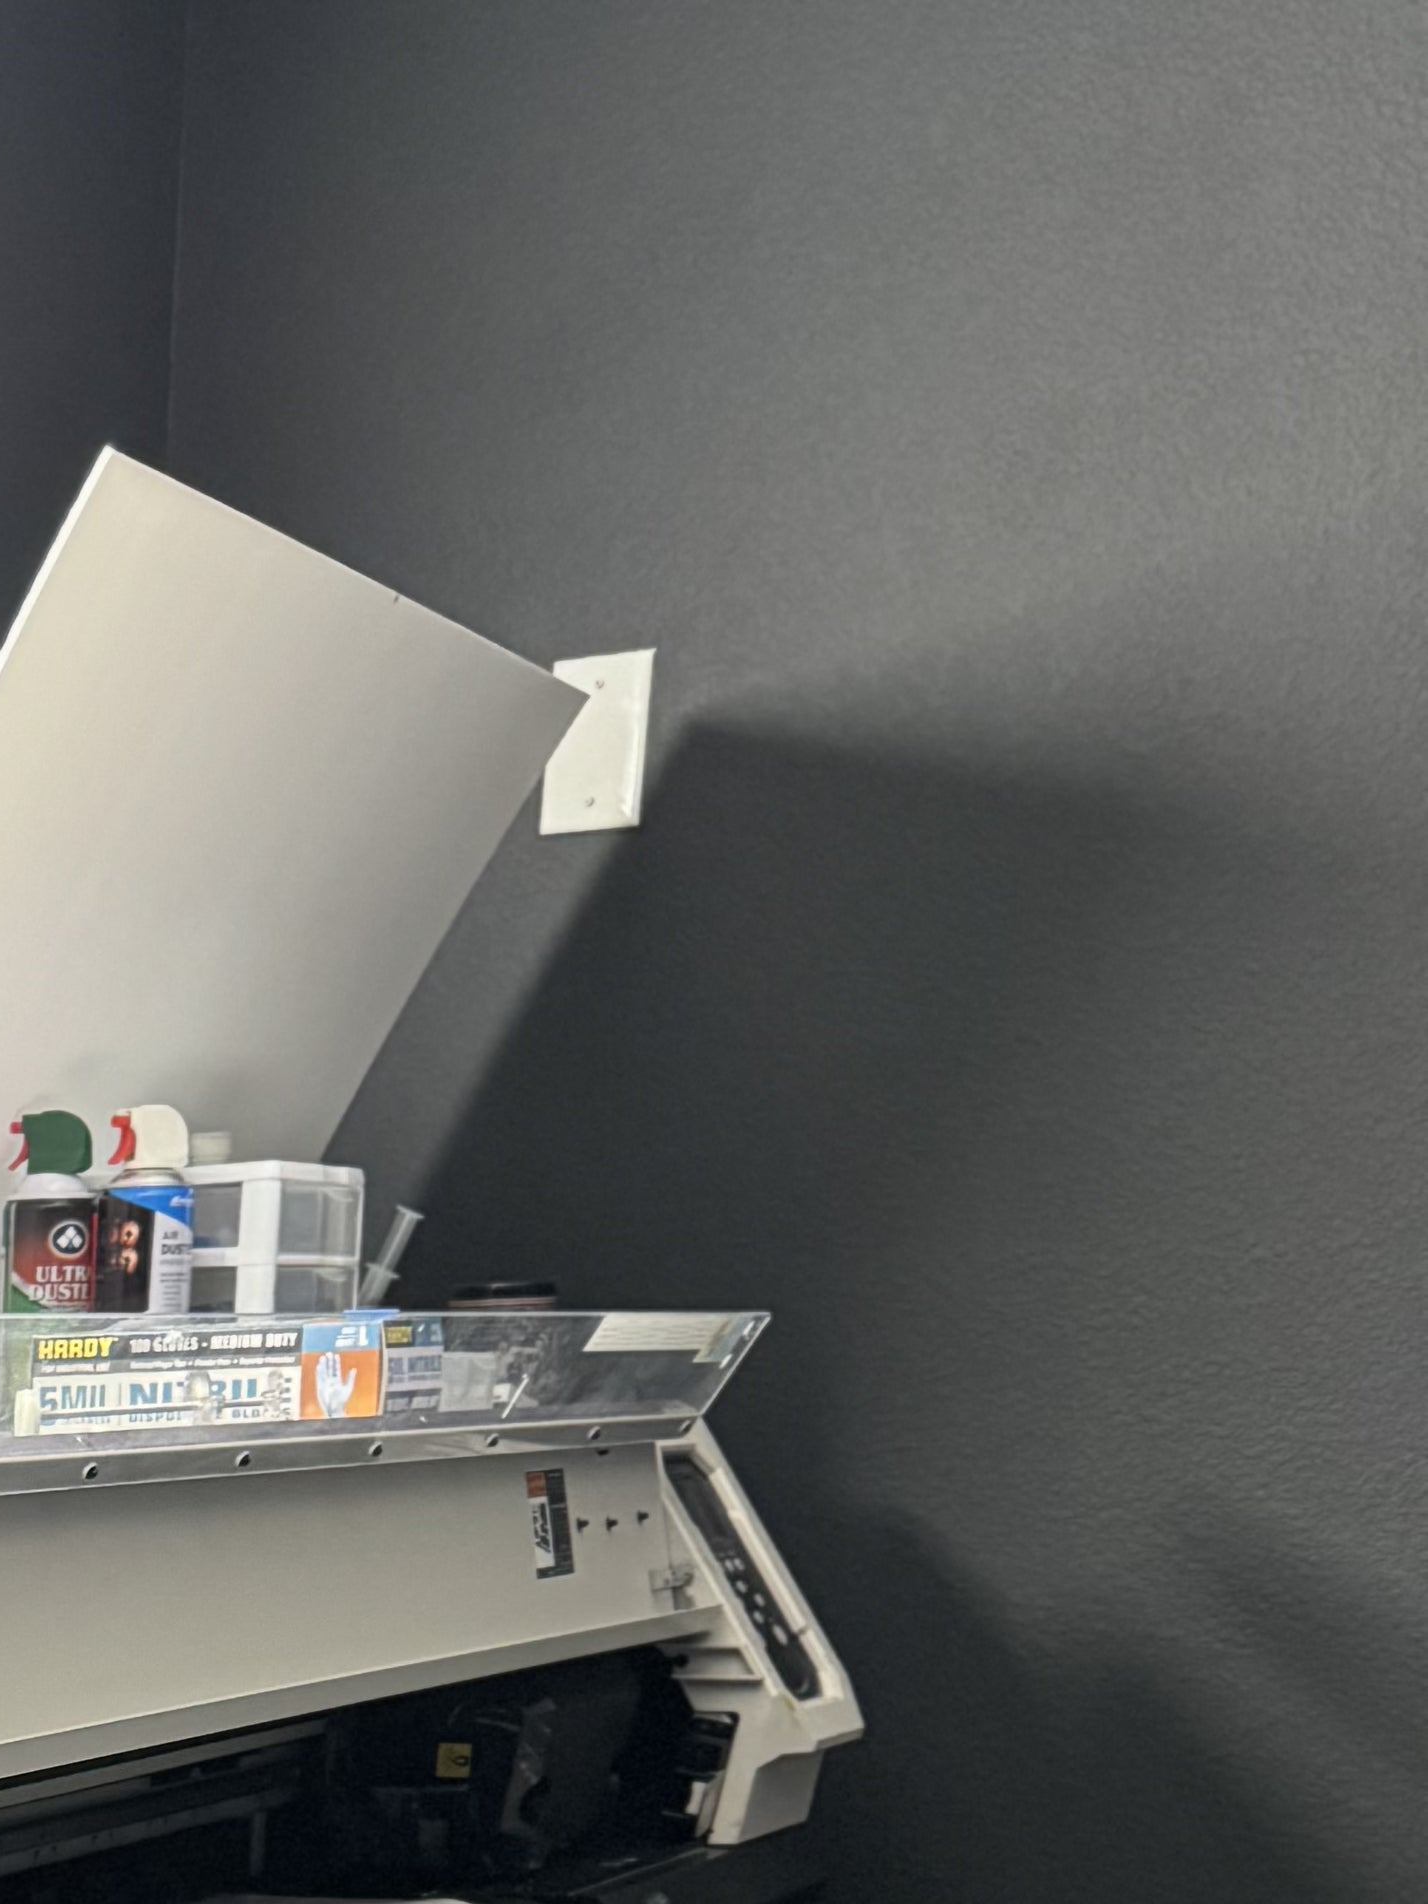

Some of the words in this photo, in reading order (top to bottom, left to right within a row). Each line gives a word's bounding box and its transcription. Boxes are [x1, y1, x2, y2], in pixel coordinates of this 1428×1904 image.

[36, 1265, 89, 1282] ULTR
[38, 1337, 114, 1359] HARDY
[210, 1333, 263, 1350] MEDIUM
[264, 1332, 299, 1348] DUTY
